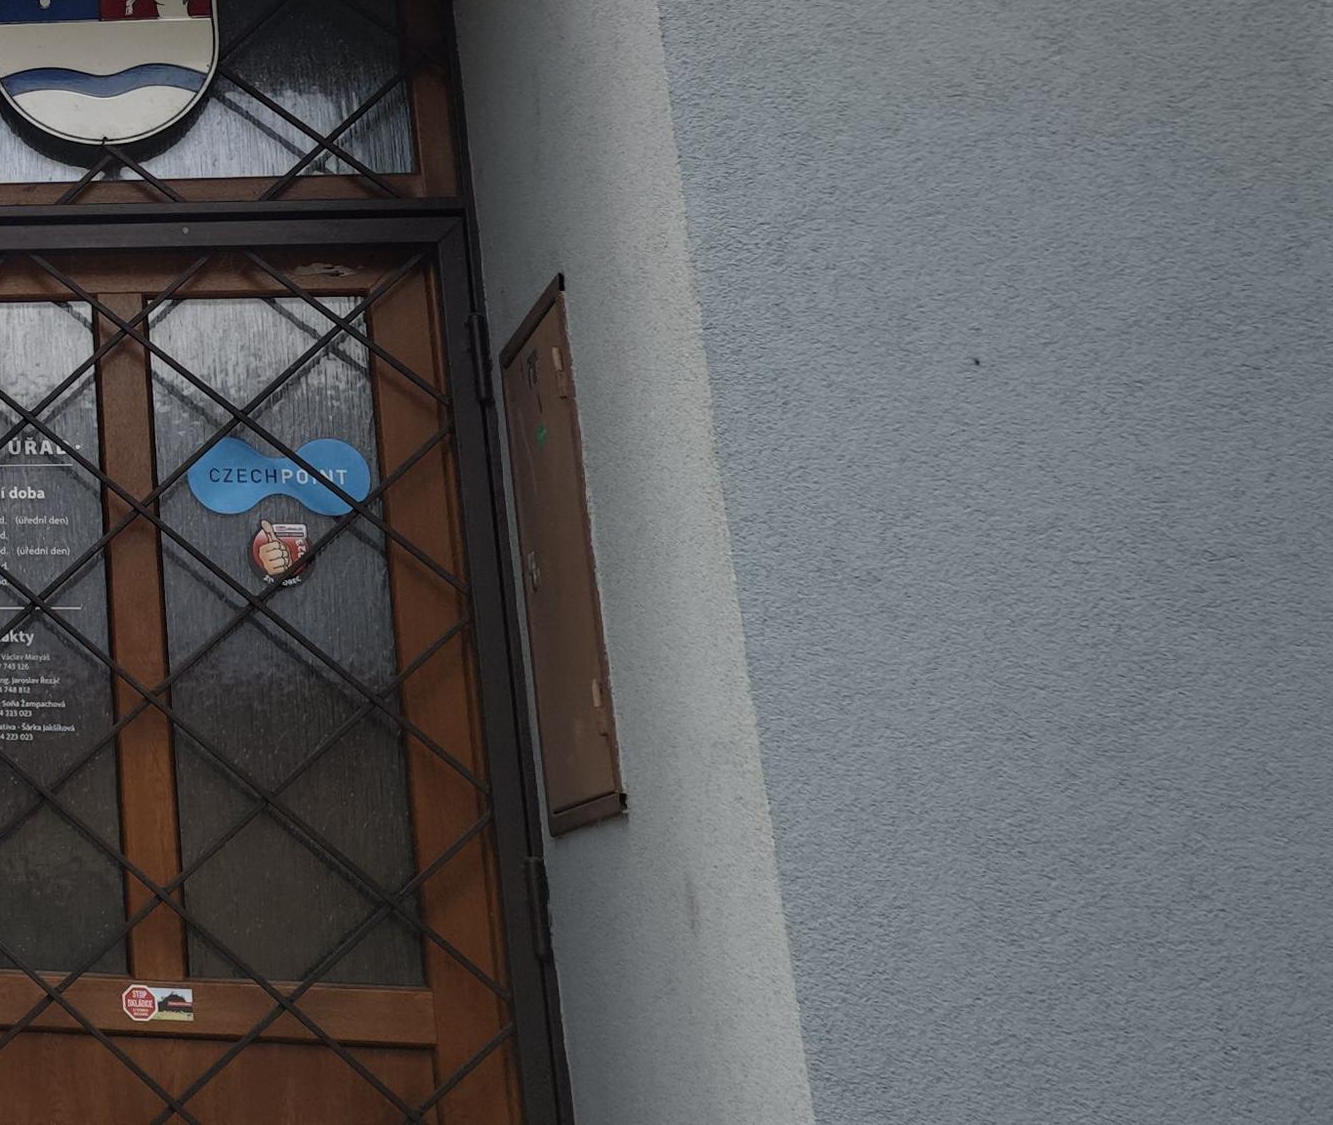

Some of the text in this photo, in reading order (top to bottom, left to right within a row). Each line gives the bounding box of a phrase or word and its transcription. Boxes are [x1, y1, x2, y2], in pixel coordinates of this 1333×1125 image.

[9, 486, 45, 499] doba
[48, 515, 69, 525] den)
[50, 546, 70, 556] den)
